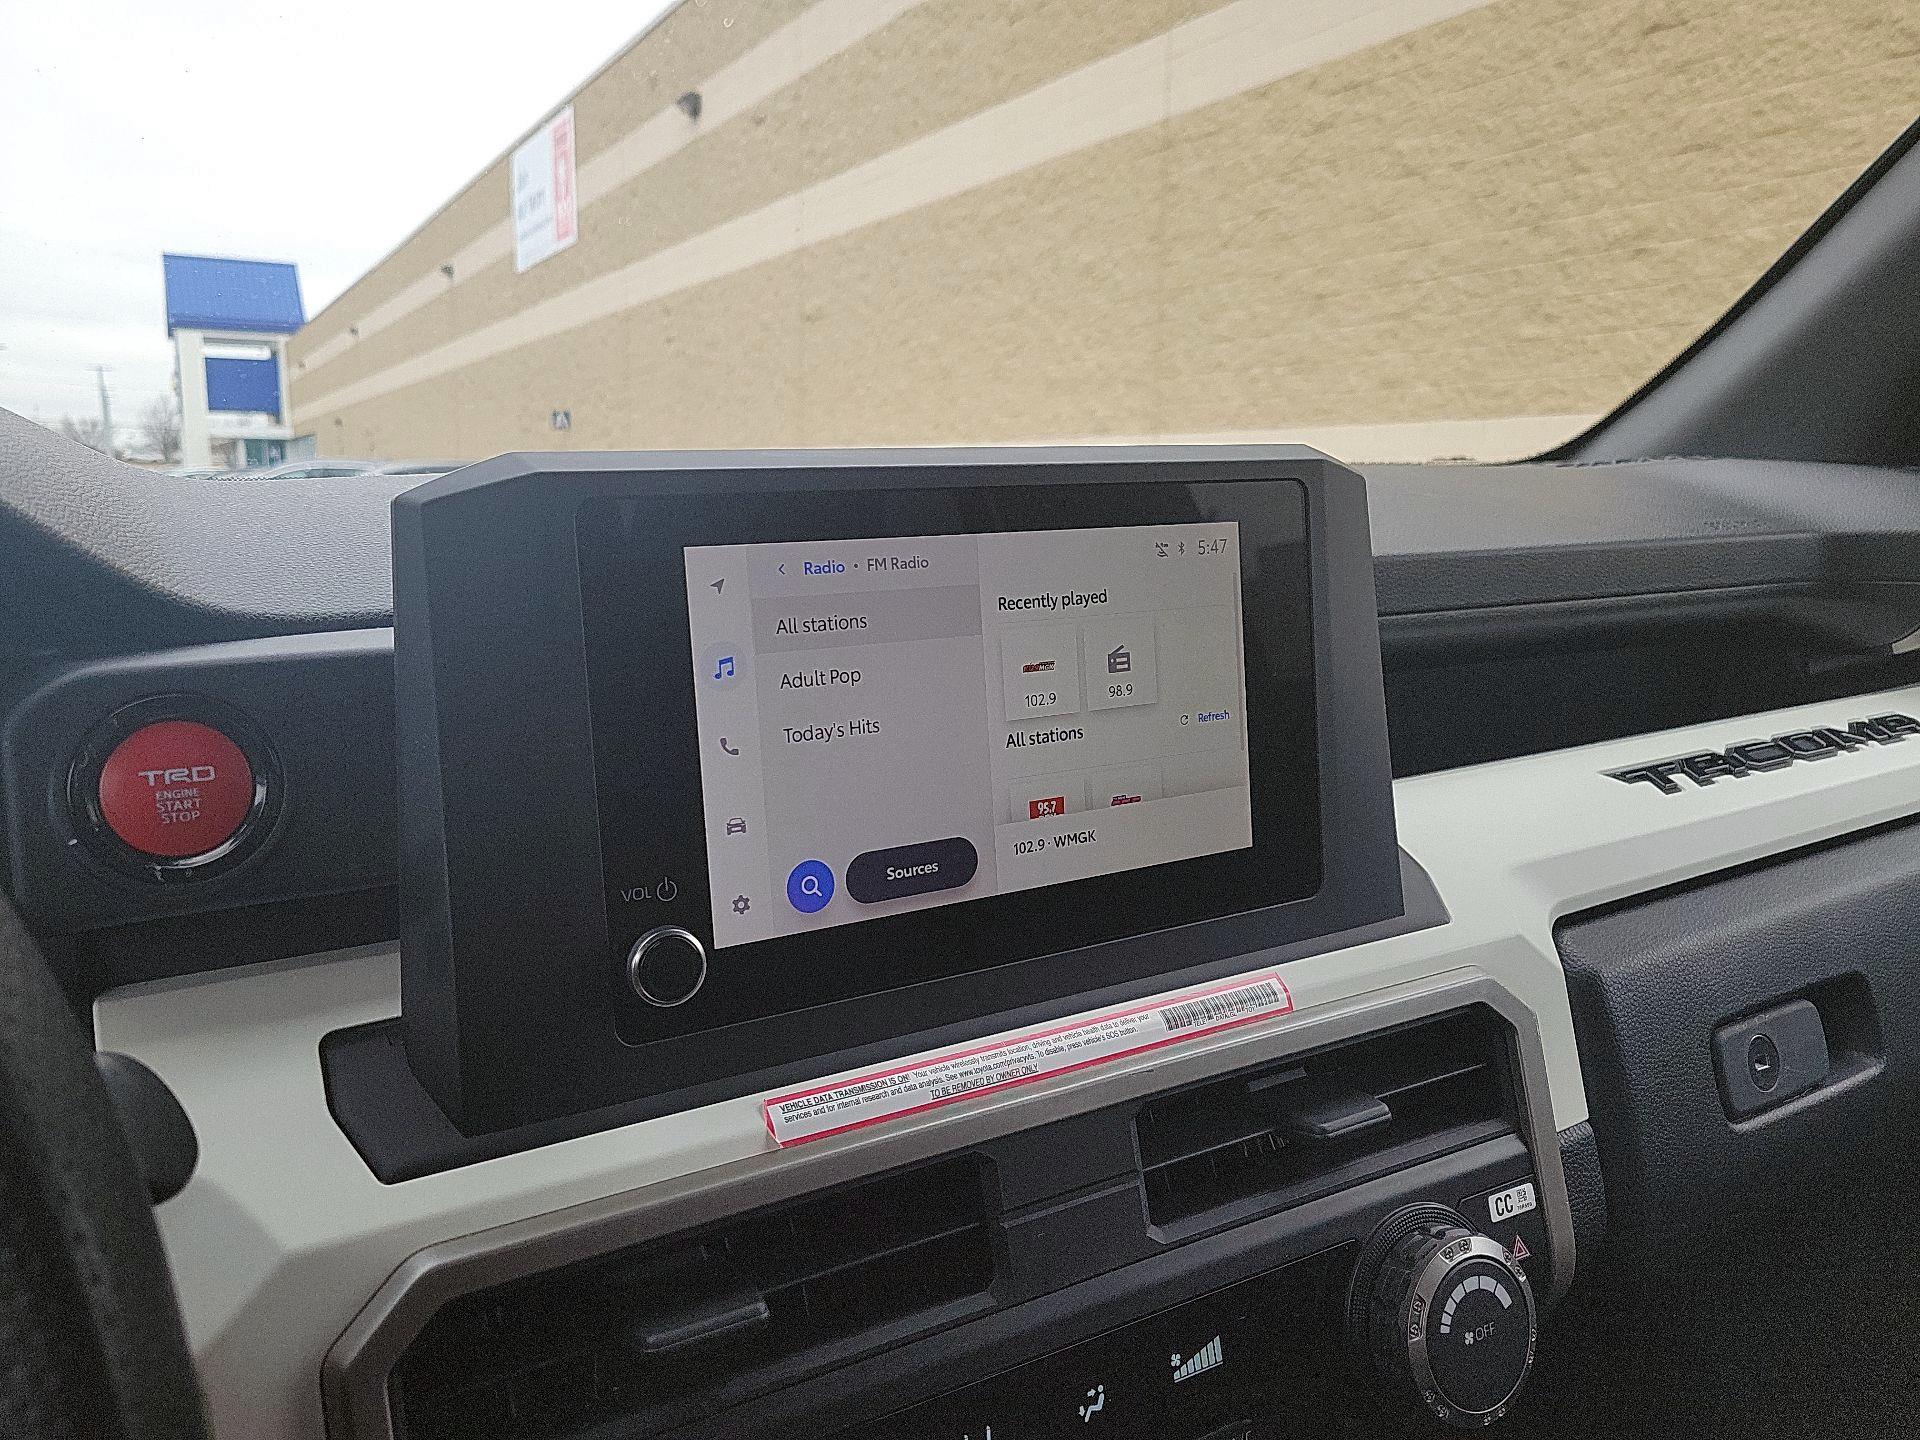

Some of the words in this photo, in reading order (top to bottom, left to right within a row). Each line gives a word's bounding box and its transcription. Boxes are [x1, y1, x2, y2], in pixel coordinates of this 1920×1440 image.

[1198, 539, 1229, 555] 5:47
[804, 559, 845, 575] Radio
[866, 557, 888, 571] FM
[891, 556, 929, 570] Radio
[998, 592, 1058, 612] Recently
[1062, 589, 1108, 609] played
[776, 617, 798, 635] All
[802, 615, 868, 633] stations
[780, 670, 826, 689] Adult
[830, 669, 861, 686] Pop
[1024, 692, 1057, 707] 102.9
[1108, 684, 1133, 698] 98.9
[1198, 710, 1230, 723] Refresh
[783, 723, 845, 744] Today's
[849, 719, 880, 736] Hits
[1005, 732, 1026, 749] All
[1029, 728, 1084, 746] stations
[1600, 713, 1920, 795] TACOMA
[138, 765, 216, 786] TRD
[155, 788, 200, 799] ENGINE
[156, 799, 201, 813] START
[1037, 801, 1056, 814] 95.7
[161, 811, 200, 824] STOP
[1013, 839, 1045, 855] 102.9
[1053, 830, 1096, 848] WMGK
[886, 861, 939, 880] Sources
[621, 887, 652, 902] VOL
[779, 1097, 814, 1113] VEHICLE
[812, 1092, 834, 1104] DATA
[833, 1078, 888, 1099] TRANSMISSION
[888, 1076, 897, 1085] IS
[912, 1068, 927, 1079] Your
[927, 1063, 950, 1075] vehicle
[1031, 1038, 1051, 1050] driving
[1050, 1035, 1062, 1043] and
[1136, 1013, 1150, 1022] your
[783, 1110, 812, 1123] services
[812, 1105, 826, 1116] and
[825, 1103, 837, 1113] for
[836, 1096, 861, 1110] internal
[860, 1089, 889, 1104] research
[889, 1085, 903, 1096] and
[902, 1082, 918, 1092] data
[944, 1072, 958, 1081] See
[1035, 1049, 1044, 1058] To
[1066, 1041, 1082, 1051] press
[1105, 1030, 1119, 1039] SOS
[929, 1088, 941, 1098] TO
[940, 1085, 952, 1096] BE
[950, 1076, 985, 1093] REMOVED
[984, 1074, 996, 1084] BY
[994, 1067, 1021, 1081] OWNER
[1020, 1062, 1039, 1074] ONLY
[1495, 1196, 1513, 1216] CC
[1475, 1321, 1495, 1340] OFF
